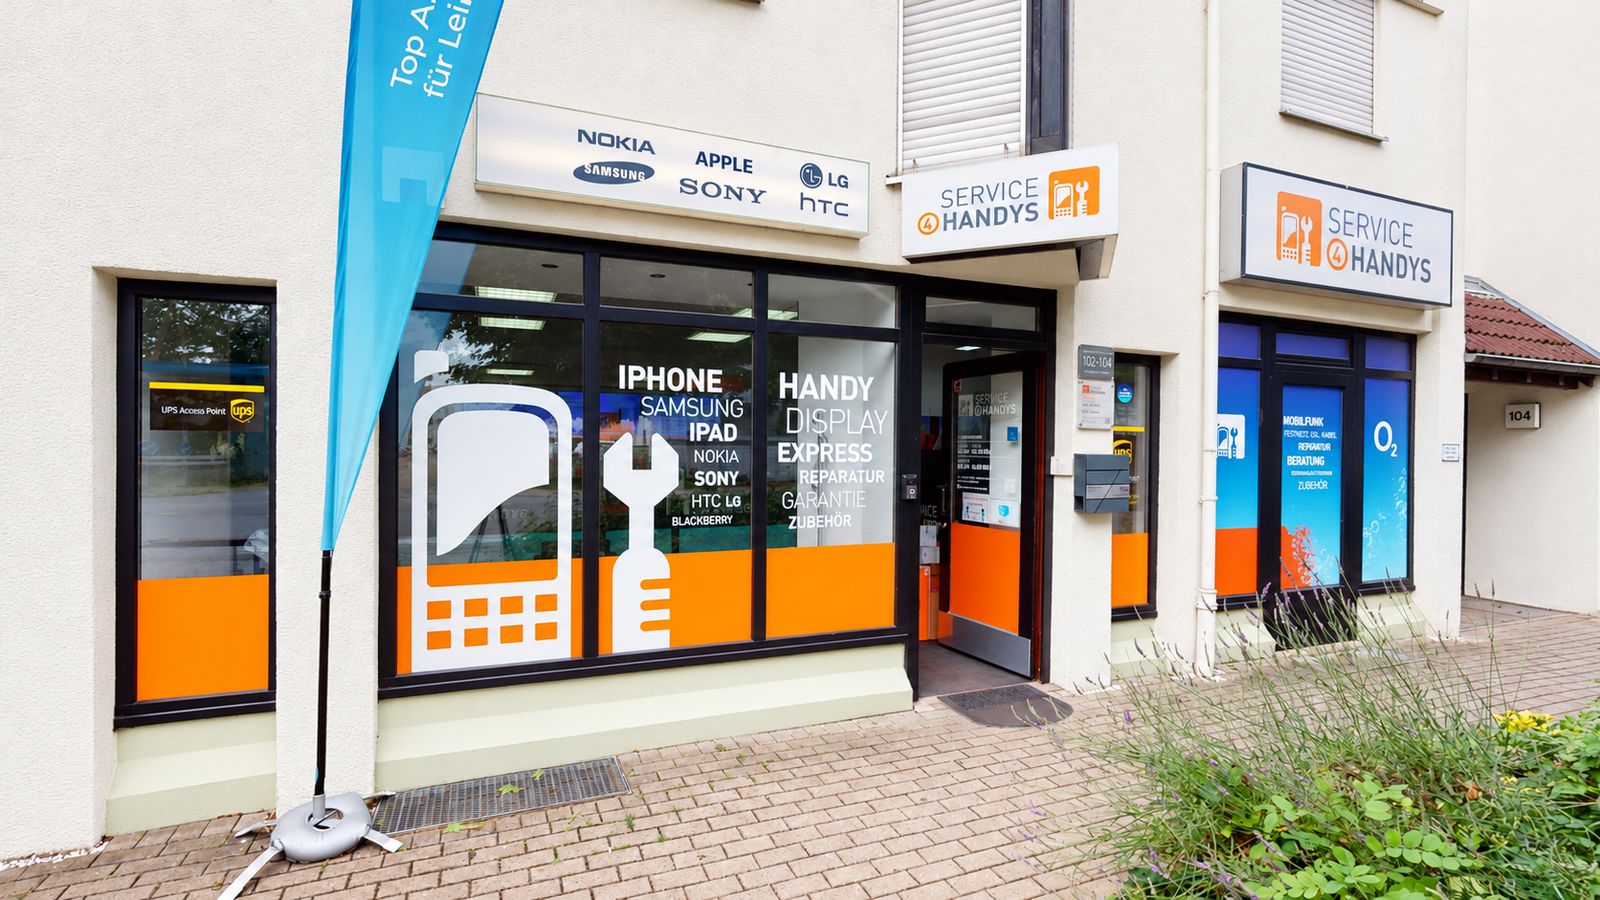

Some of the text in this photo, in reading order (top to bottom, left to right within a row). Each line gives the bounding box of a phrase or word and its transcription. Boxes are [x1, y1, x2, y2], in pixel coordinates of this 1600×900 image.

[390, 0, 437, 87] Top A
[423, 53, 453, 98] für
[577, 129, 656, 155] NOKIA
[584, 163, 646, 181] SAMSUNG
[695, 151, 753, 174] APPLE
[828, 172, 849, 189] LG
[679, 178, 767, 204] SONY
[941, 177, 1039, 209] SERVICE
[943, 202, 1039, 232] HANDYS
[1328, 207, 1414, 248] SERVICE
[1351, 245, 1432, 284] HANDYS
[618, 364, 723, 393] IPHONE
[779, 372, 875, 401] HANDY
[161, 406, 226, 415] UPS Access Point
[232, 407, 253, 418] ups
[641, 396, 744, 418] SAMSUNG
[1508, 411, 1532, 421] 104
[786, 407, 888, 435] DISPLAY
[1283, 415, 1324, 427] MOBILFUNK
[689, 422, 738, 442] IPAD
[694, 449, 740, 464] NOKIA
[777, 442, 873, 463] EXPRESS
[1286, 455, 1325, 466] BERATUNG
[694, 471, 740, 487] SONY
[800, 469, 885, 484] REPARATUR
[691, 493, 721, 509] HTC
[725, 495, 742, 508] LG
[781, 490, 867, 509] GARANTIE
[672, 515, 733, 527] BLACKBERRY
[788, 512, 852, 529] ZUBEHÖR
